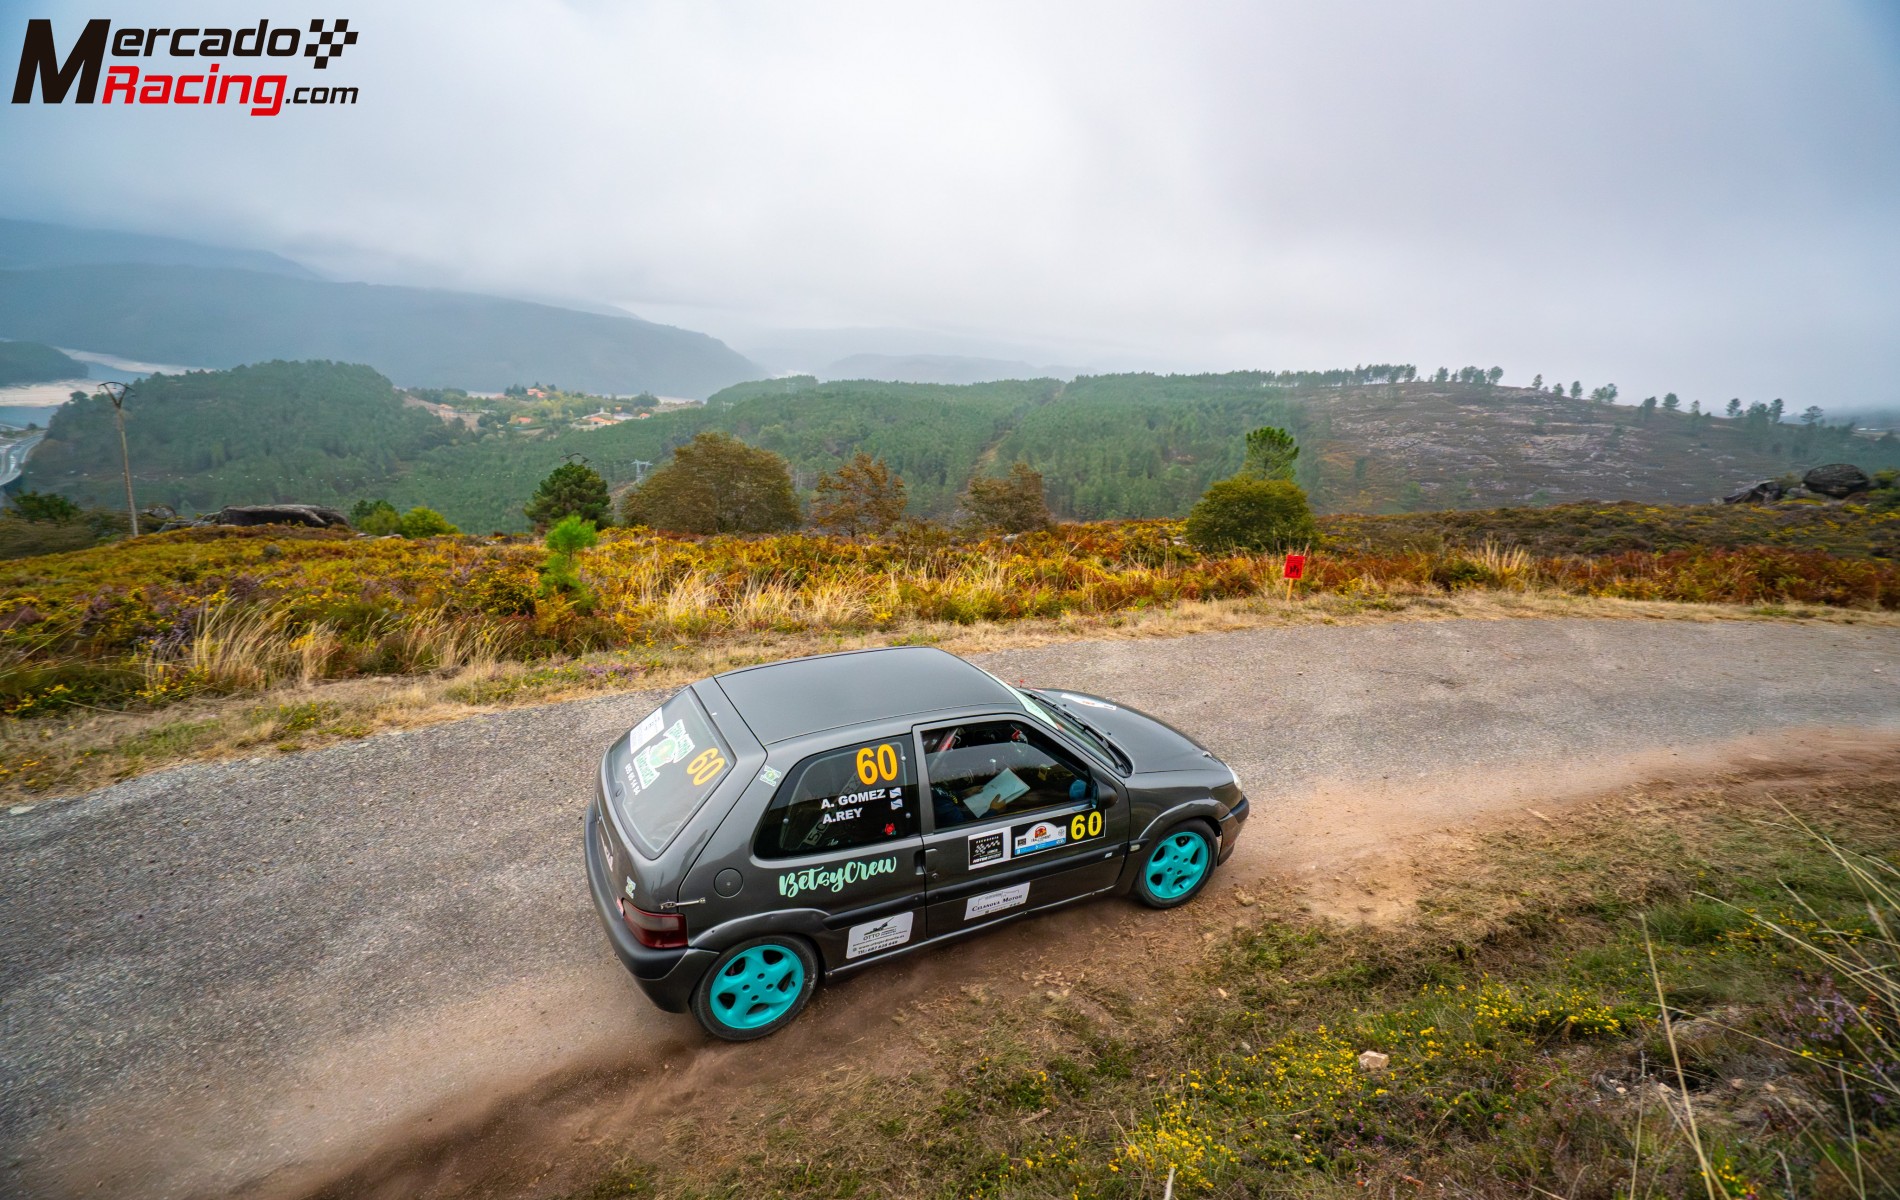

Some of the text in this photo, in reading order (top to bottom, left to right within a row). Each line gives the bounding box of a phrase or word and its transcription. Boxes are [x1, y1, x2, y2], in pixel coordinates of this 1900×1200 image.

[687, 747, 725, 786] 60
[856, 743, 898, 786] 60
[820, 788, 886, 810] A. GOMEZ
[822, 807, 864, 824] A.REY
[1070, 811, 1102, 840] 60
[778, 856, 897, 898] BetsyCrew
[863, 932, 881, 941] OTTO
